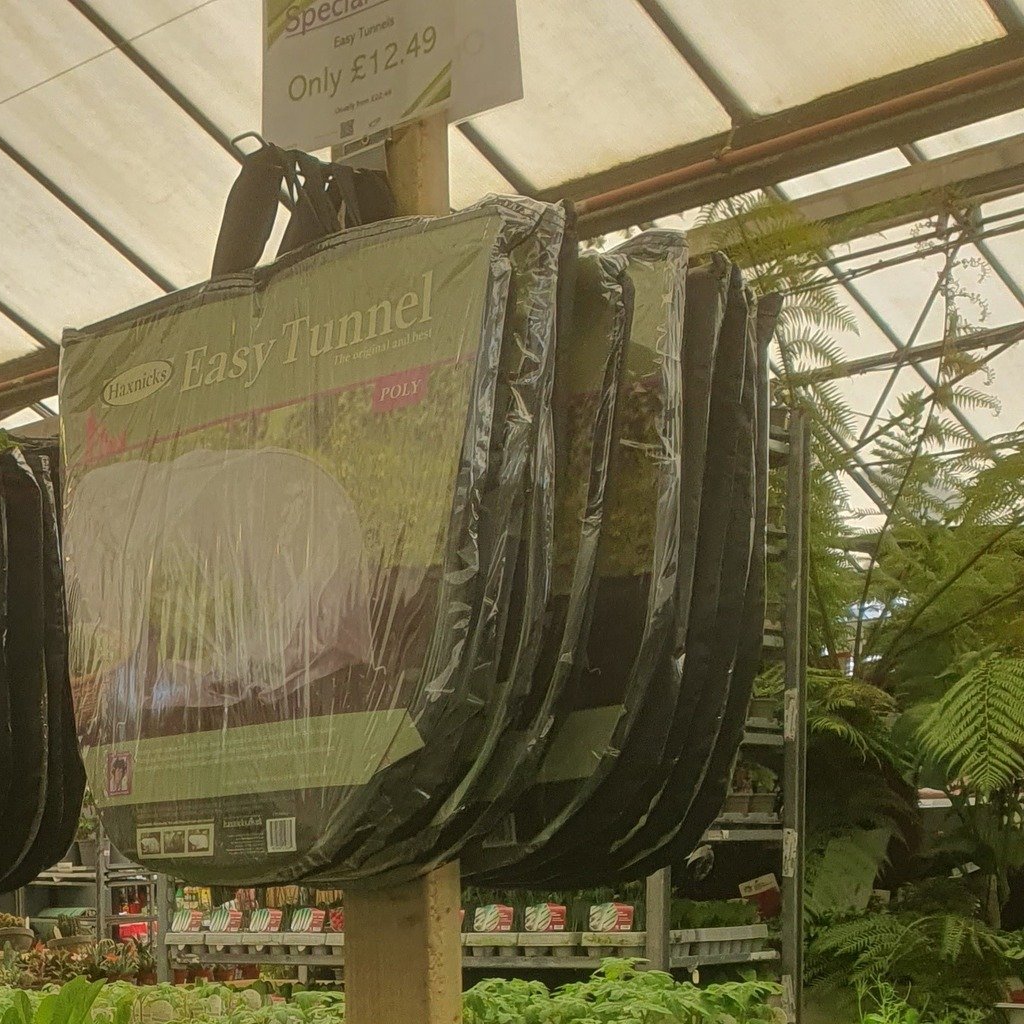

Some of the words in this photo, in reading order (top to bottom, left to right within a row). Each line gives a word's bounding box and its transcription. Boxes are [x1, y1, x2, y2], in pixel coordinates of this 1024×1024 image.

[285, 0, 369, 35] Specia
[334, 33, 356, 48] Easy
[359, 17, 395, 39] Tunnels
[288, 66, 342, 101] Only
[350, 26, 437, 83] £12.49
[179, 338, 277, 393] Easy
[281, 270, 432, 366] Tunnel
[333, 352, 351, 366] The
[412, 328, 432, 346] best
[107, 366, 167, 400] Haxnicks
[379, 379, 422, 402] POLY
